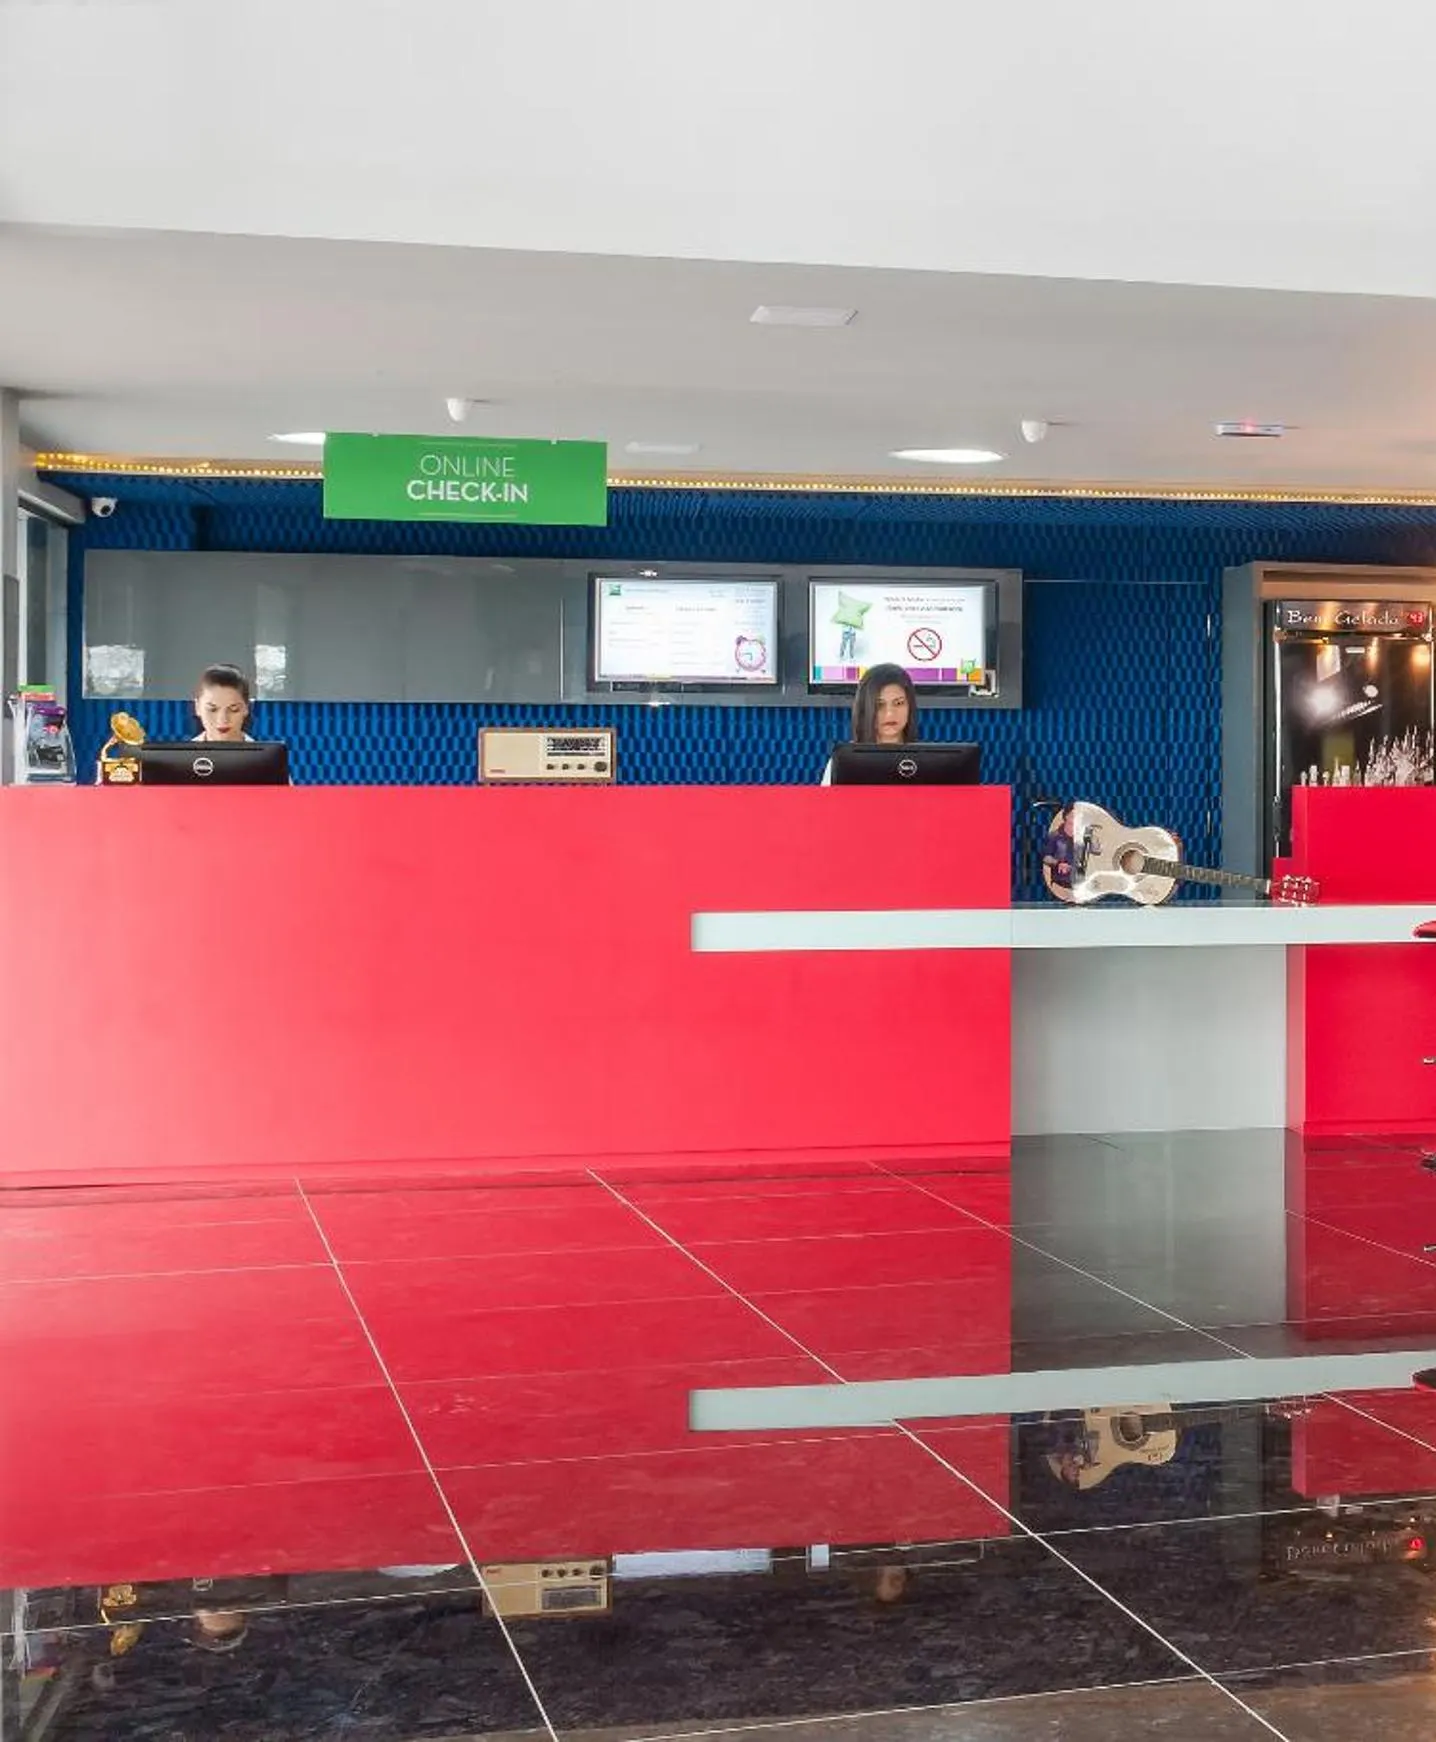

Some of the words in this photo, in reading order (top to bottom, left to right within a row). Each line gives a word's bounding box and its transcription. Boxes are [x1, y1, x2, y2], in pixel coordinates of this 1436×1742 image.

[420, 454, 516, 478] ONLINE
[406, 479, 528, 503] CHECK-IN
[1335, 609, 1399, 625] Gelada
